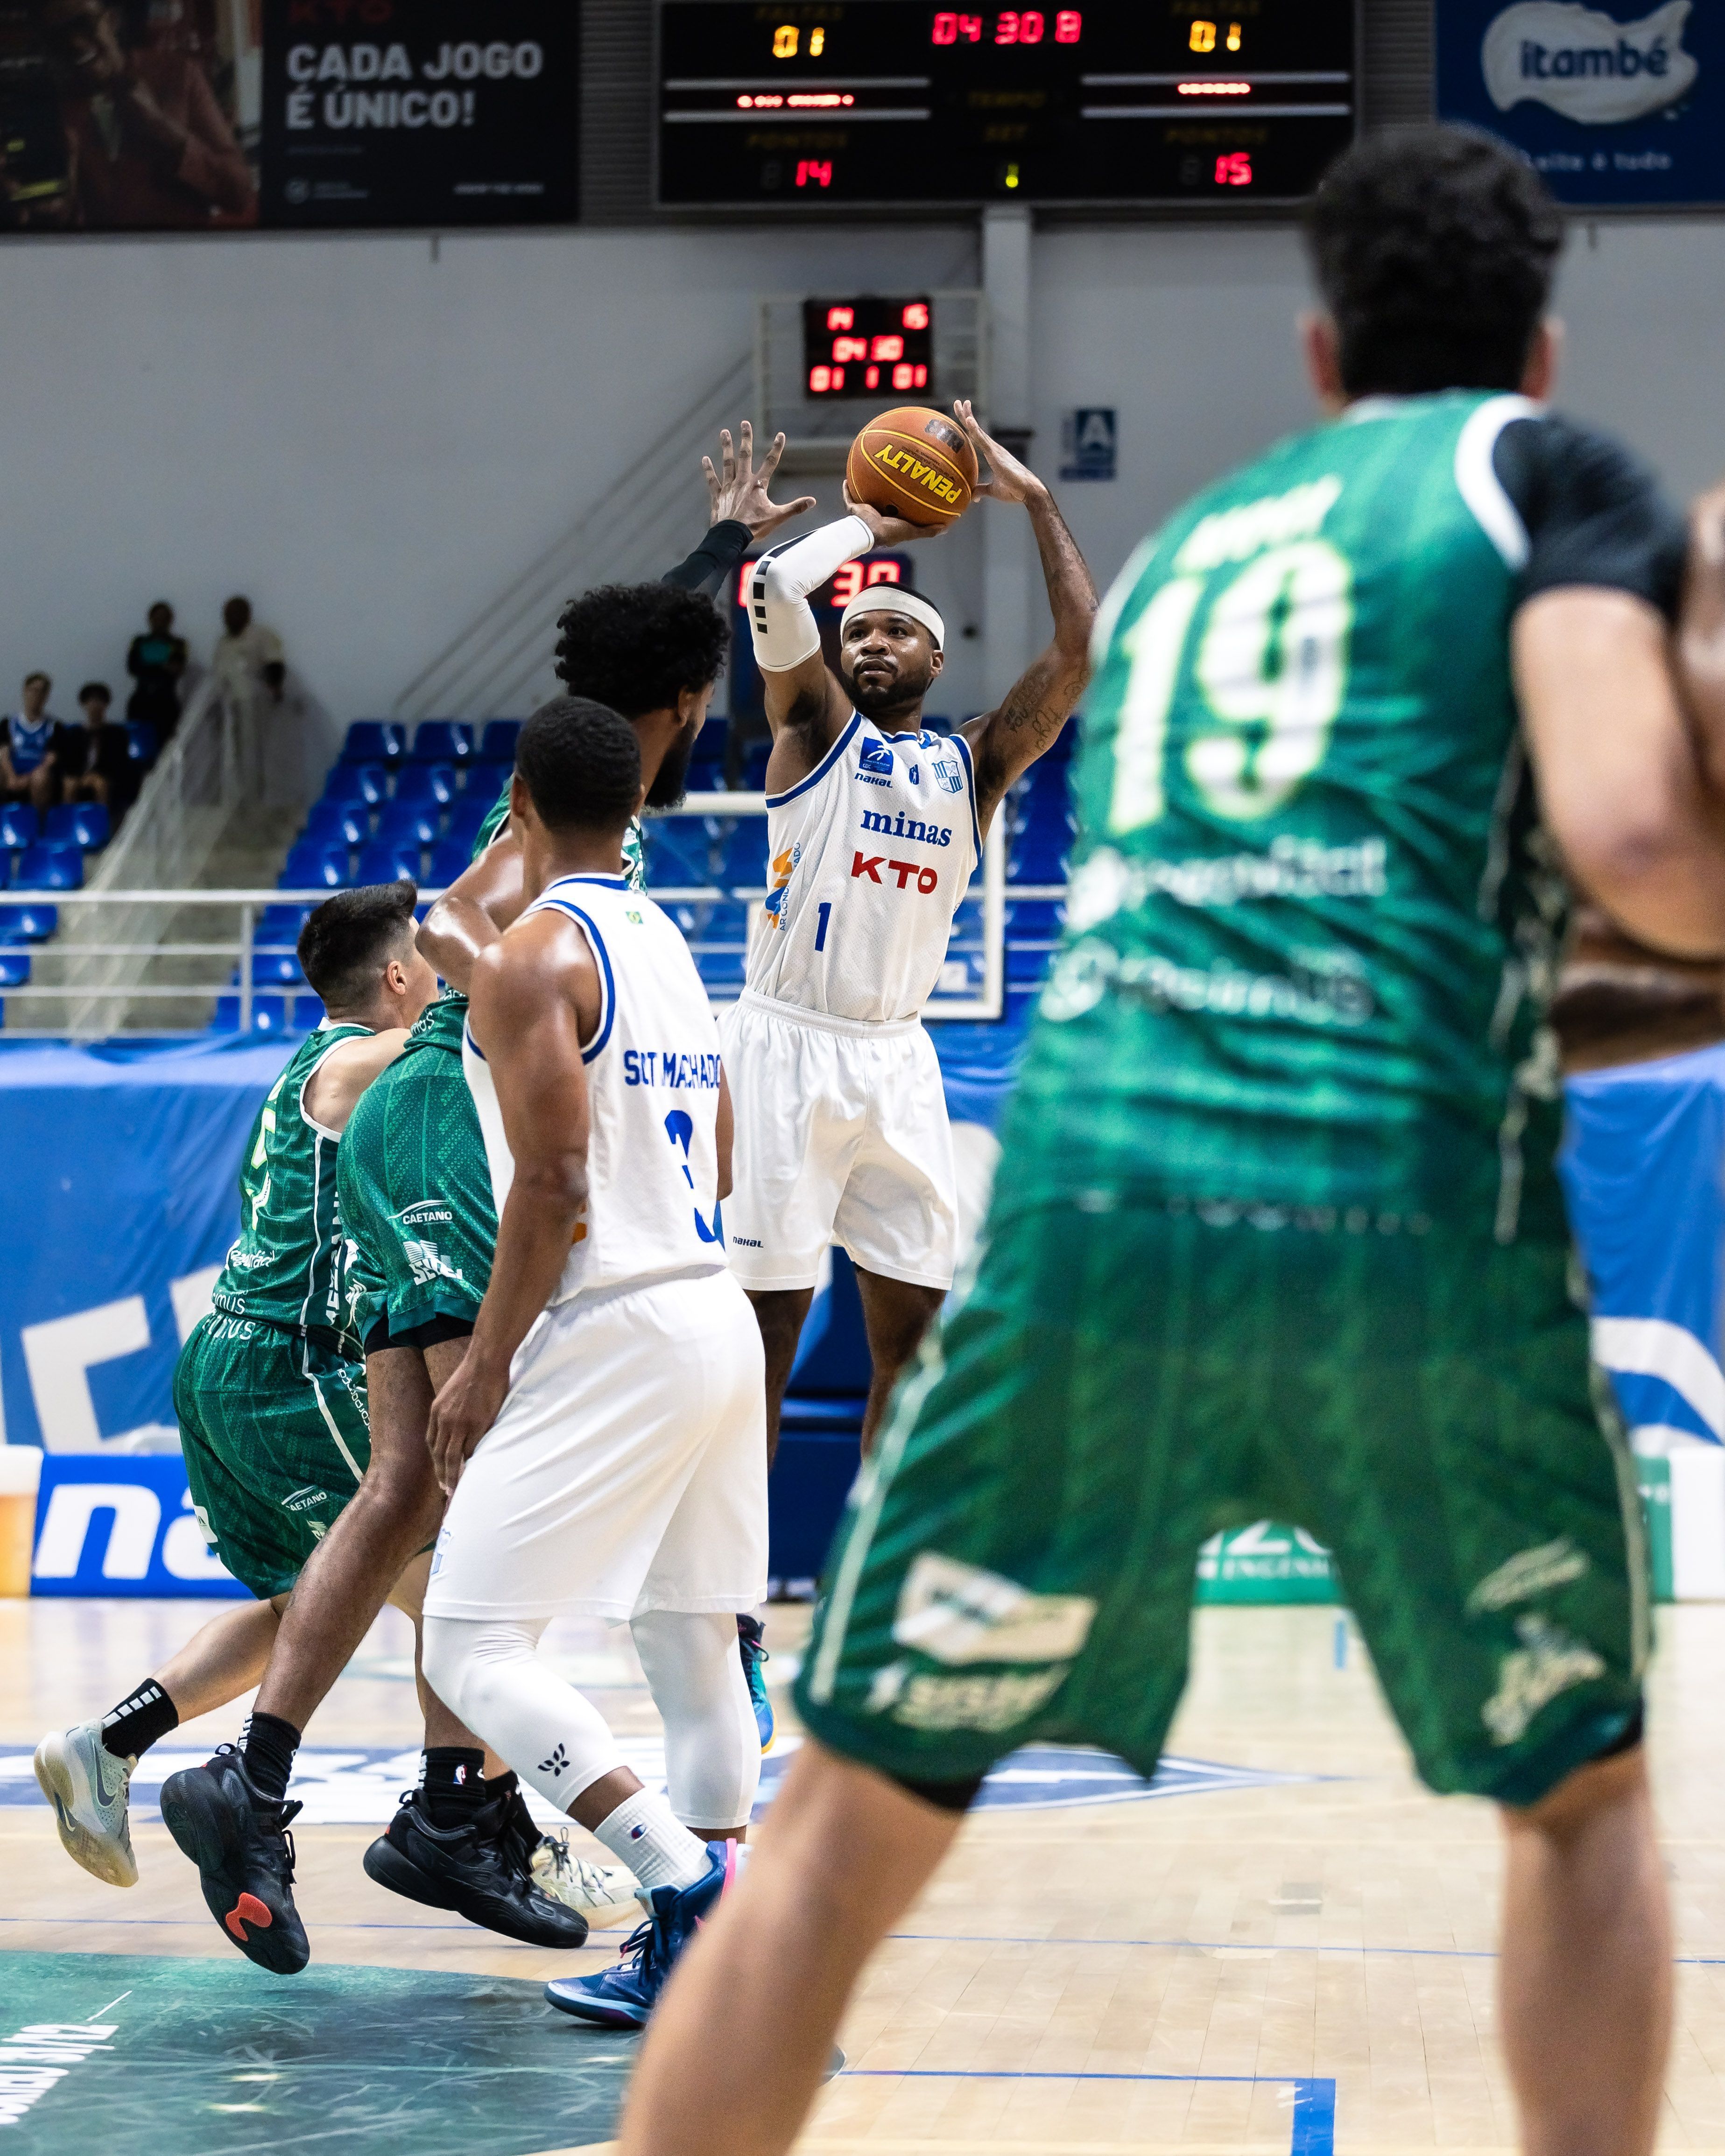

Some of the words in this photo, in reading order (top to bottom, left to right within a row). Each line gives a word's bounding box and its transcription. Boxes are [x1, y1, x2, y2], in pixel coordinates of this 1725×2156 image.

[773, 26, 824, 58] 01
[1189, 21, 1241, 52] 01
[286, 42, 415, 82] CADA
[422, 42, 544, 80] JOGO
[1521, 35, 1670, 78] itambé
[286, 84, 316, 129] É
[323, 83, 476, 129] ÚNICO!
[796, 160, 833, 187] 14
[1215, 152, 1253, 185] 15
[873, 443, 963, 504] PENALTY
[1108, 539, 1354, 834] 19
[860, 809, 952, 847] minas
[851, 851, 938, 894] KTO
[815, 902, 832, 952] 1
[403, 1211, 453, 1225] CAETANO
[286, 1491, 327, 1511] AETANO
